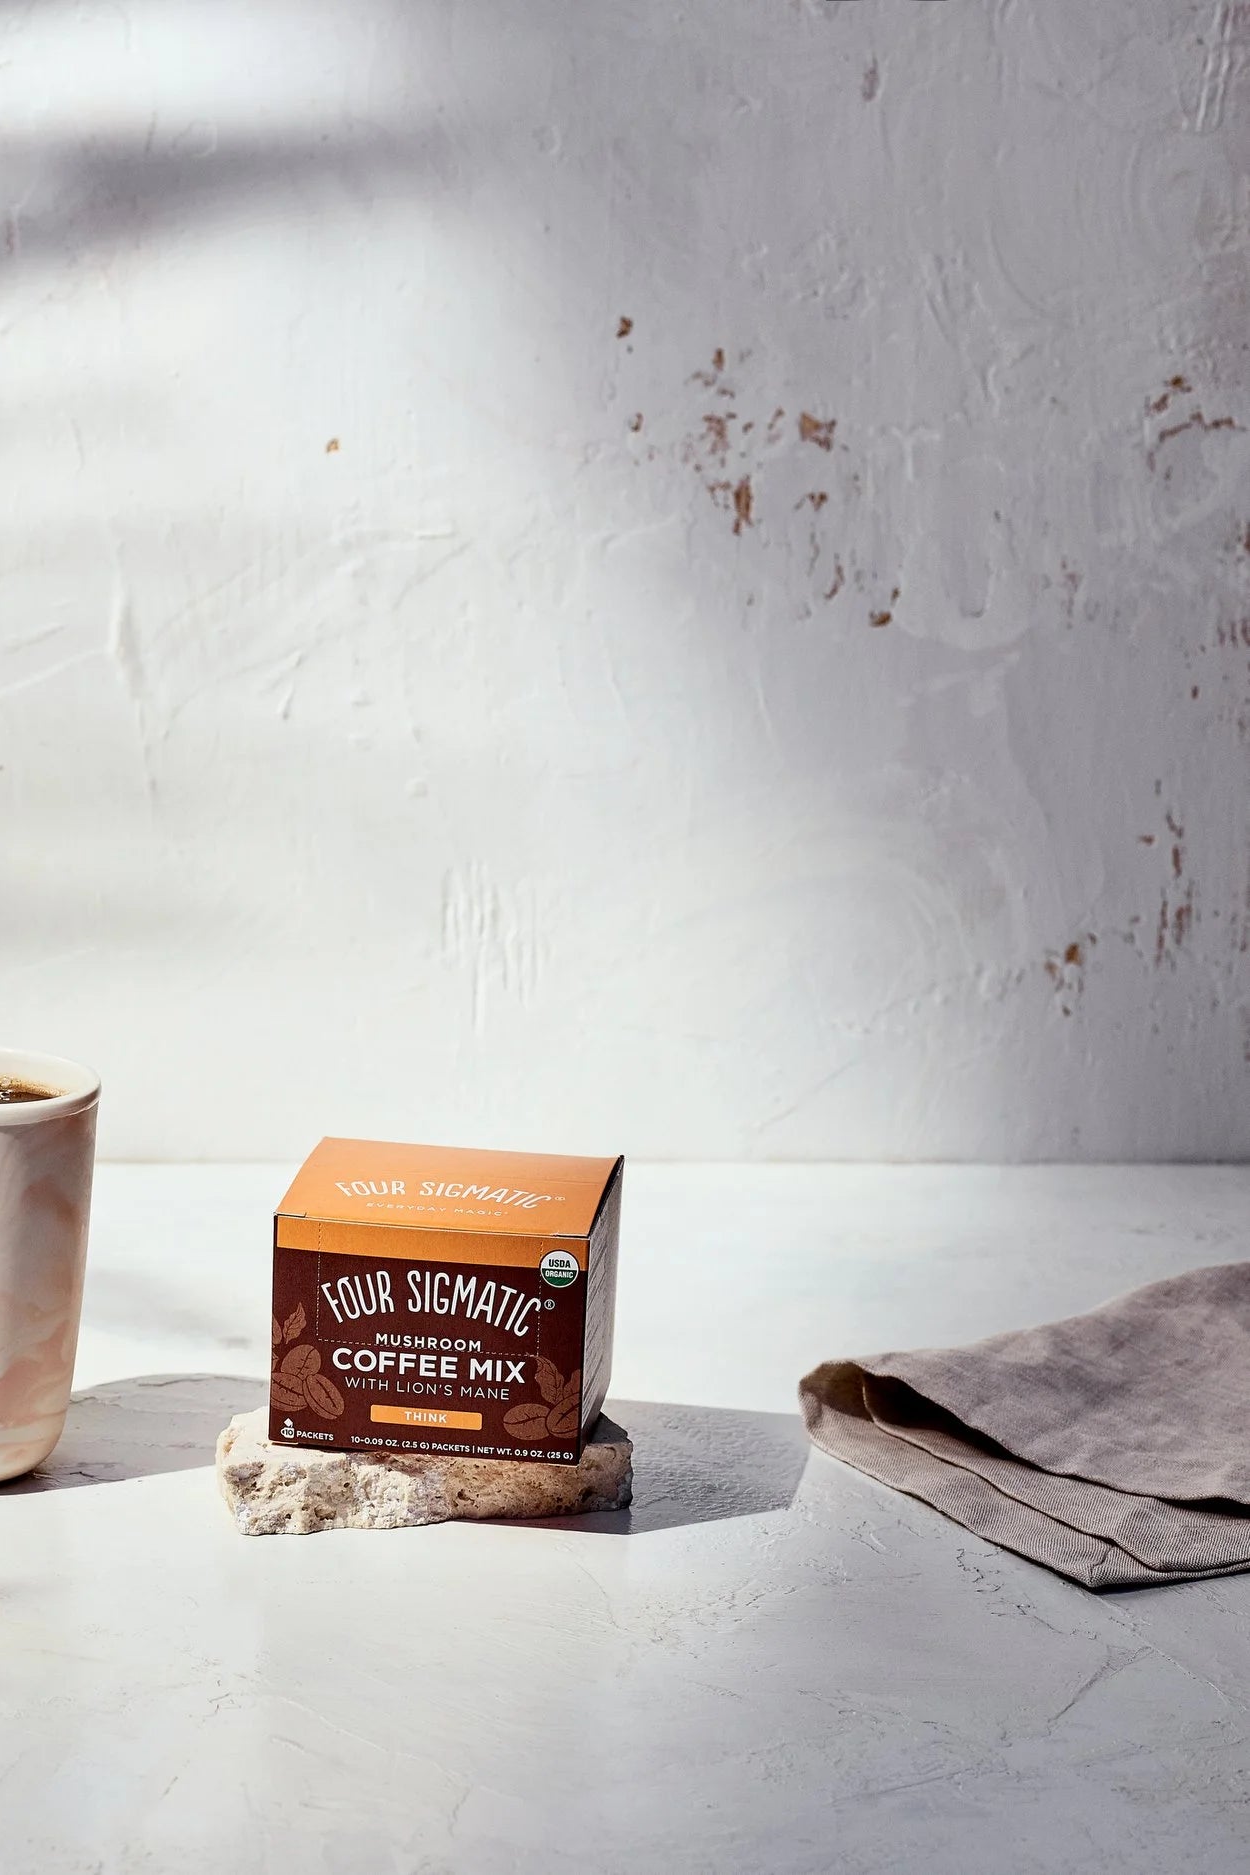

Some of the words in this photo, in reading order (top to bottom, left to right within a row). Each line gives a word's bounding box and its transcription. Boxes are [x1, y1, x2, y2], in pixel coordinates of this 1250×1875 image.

[335, 1181, 406, 1197] FOUR
[366, 1202, 446, 1212] EVERYDAY
[548, 1259, 571, 1268] USDA
[545, 1270, 574, 1278] ORGANIC
[321, 1270, 395, 1323] FOUR
[376, 1333, 481, 1352] MUSHROOM
[332, 1347, 458, 1379] COFFEE
[469, 1358, 526, 1384] MIX
[345, 1376, 389, 1391] WITH
[396, 1381, 453, 1396] LION'S
[461, 1386, 510, 1400] MANE
[404, 1411, 448, 1424] THINK
[296, 1430, 334, 1441] PACKETS
[385, 1439, 400, 1447] OZ.
[402, 1441, 418, 1449] (2.5
[419, 1441, 430, 1450] G)
[431, 1443, 470, 1453] PACKETS
[477, 1446, 494, 1454] NET
[530, 1450, 545, 1458] OZ.
[547, 1451, 561, 1459] (25
[563, 1452, 574, 1460] G)
